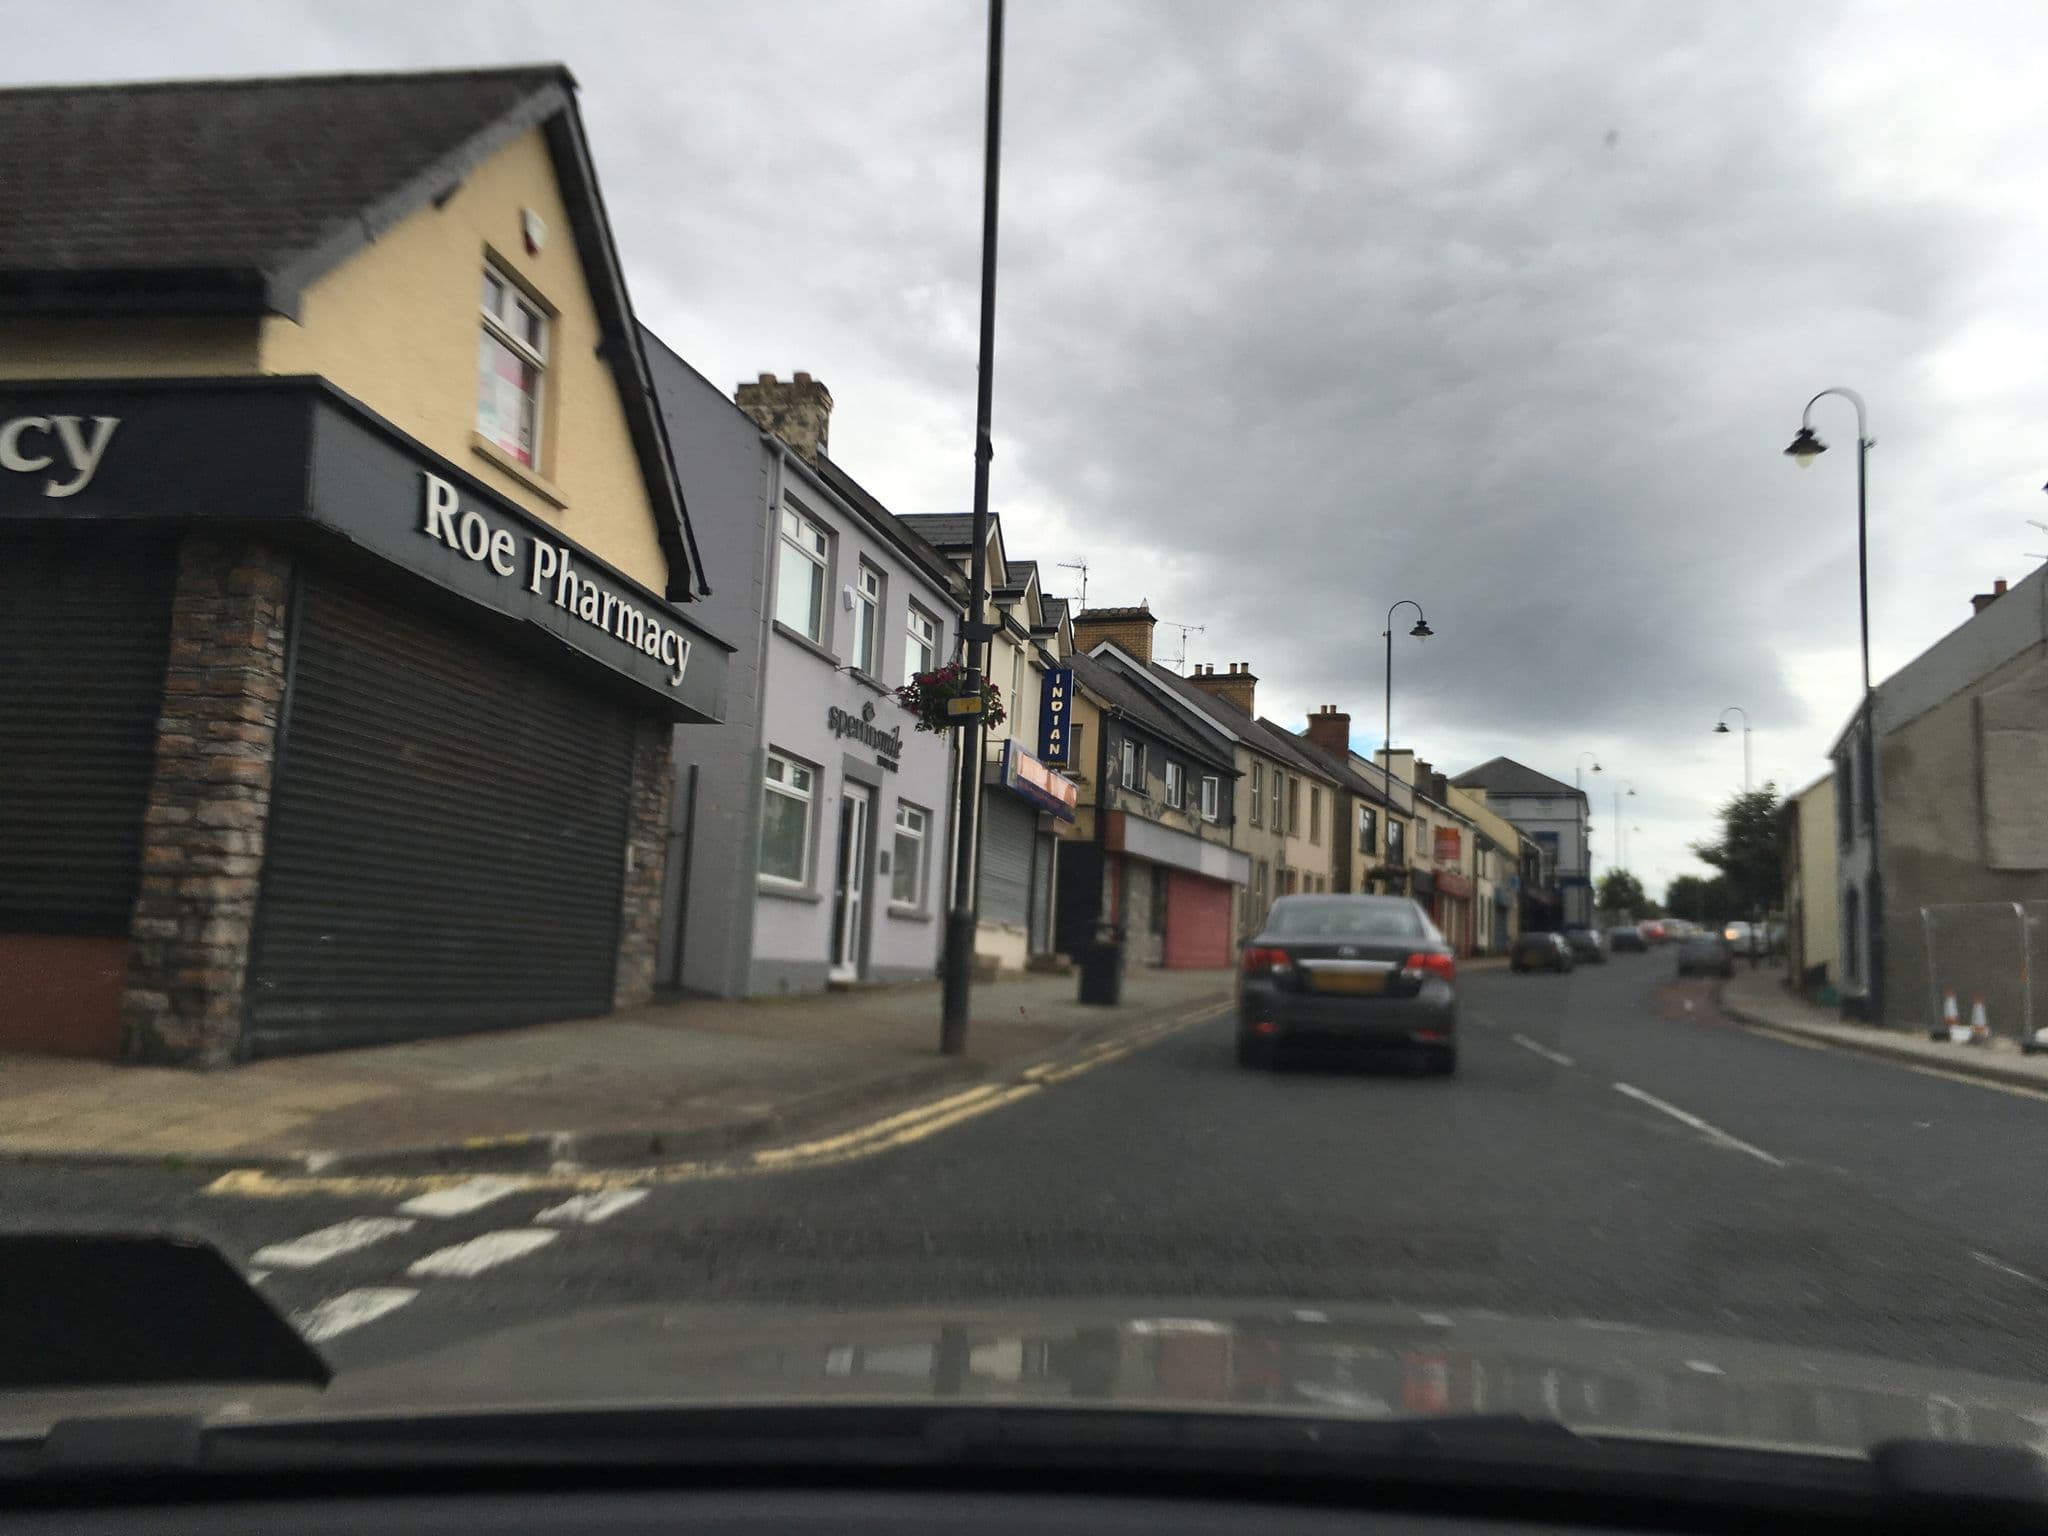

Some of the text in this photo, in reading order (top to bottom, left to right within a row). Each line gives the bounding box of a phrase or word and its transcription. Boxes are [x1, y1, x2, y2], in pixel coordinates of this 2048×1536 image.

[424, 471, 691, 687] Roe Pharmacy
[1049, 673, 1063, 755] INDIAN
